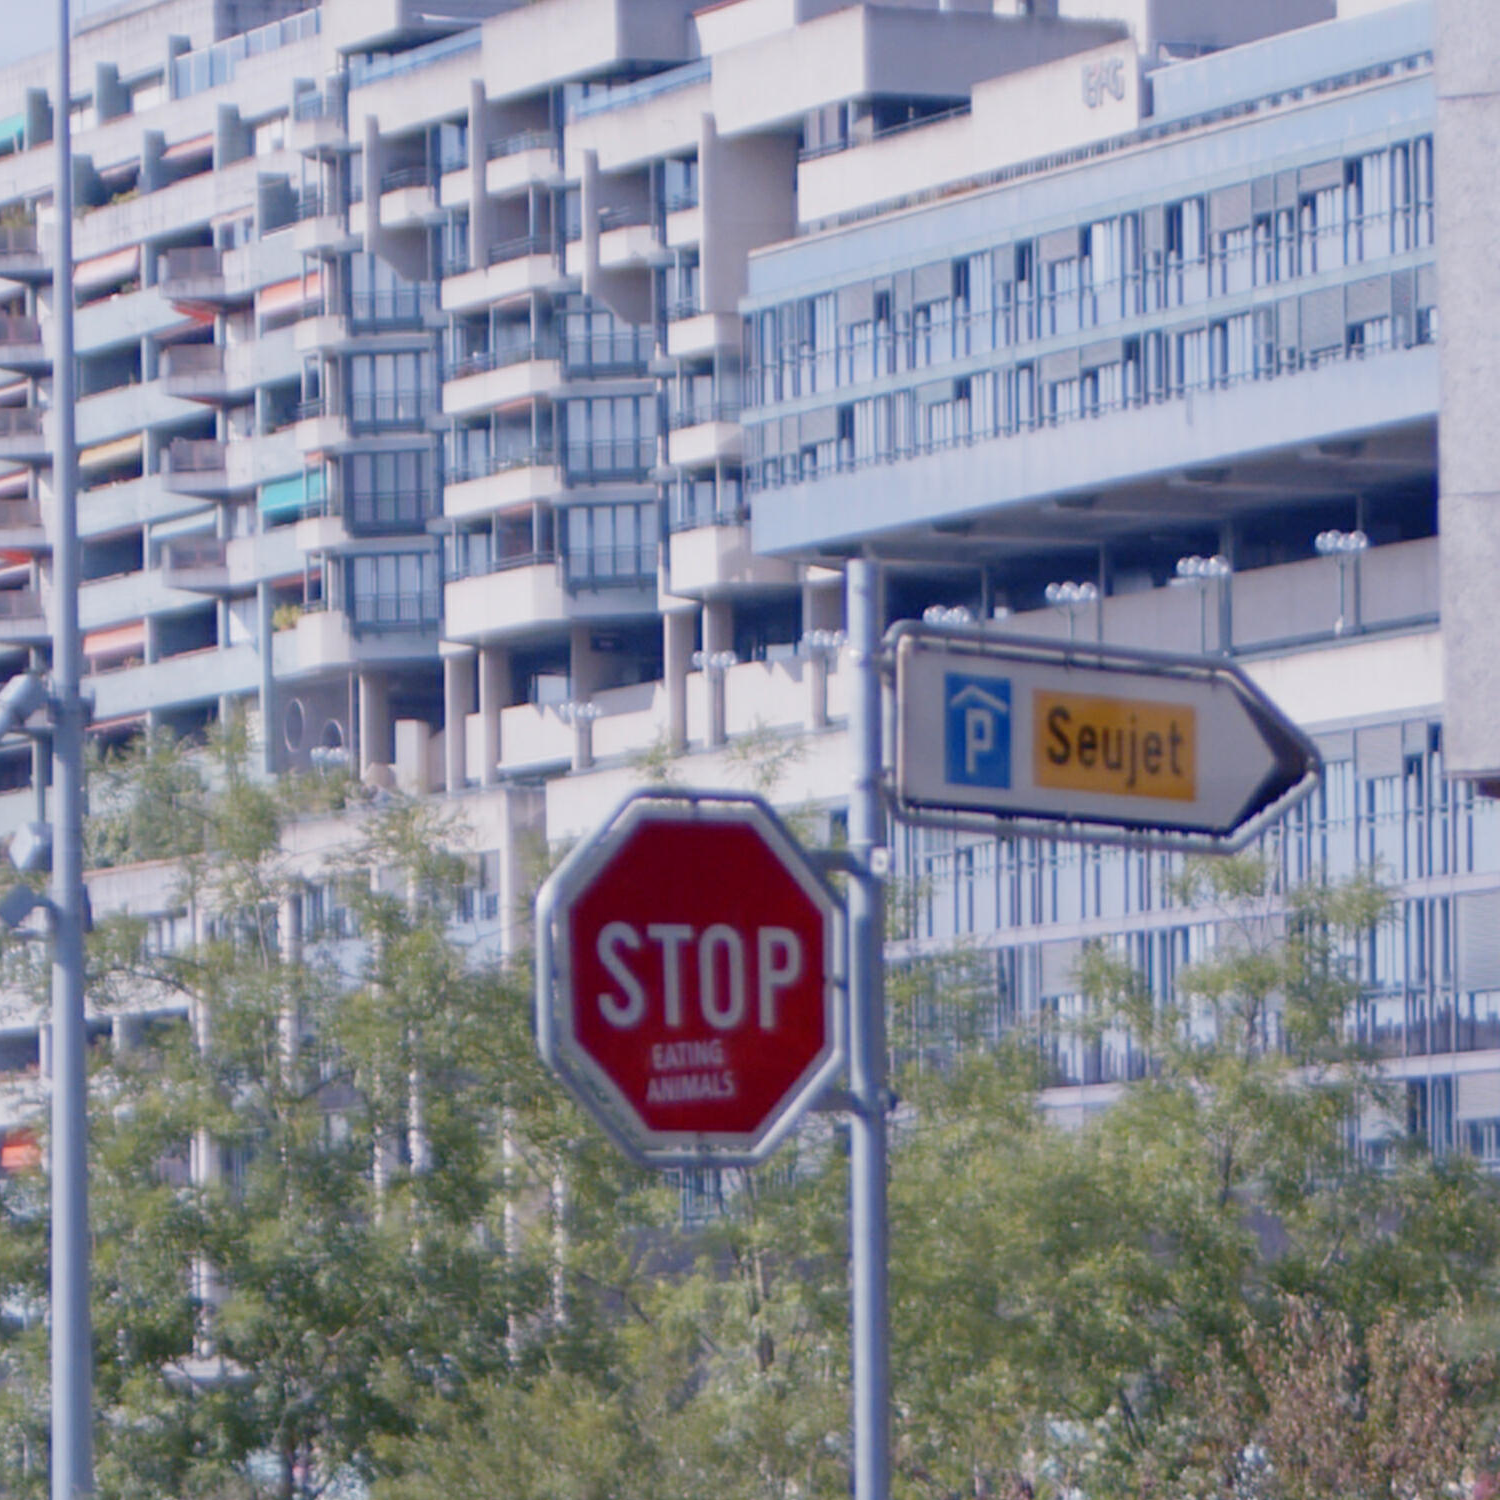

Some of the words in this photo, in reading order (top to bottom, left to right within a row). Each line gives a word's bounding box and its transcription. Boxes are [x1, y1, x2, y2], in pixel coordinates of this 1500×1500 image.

[965, 709, 994, 774] P
[1046, 705, 1183, 786] Seujet
[597, 921, 802, 1030] STOP
[652, 1039, 724, 1070] EATING
[647, 1072, 736, 1102] ANIMALS
